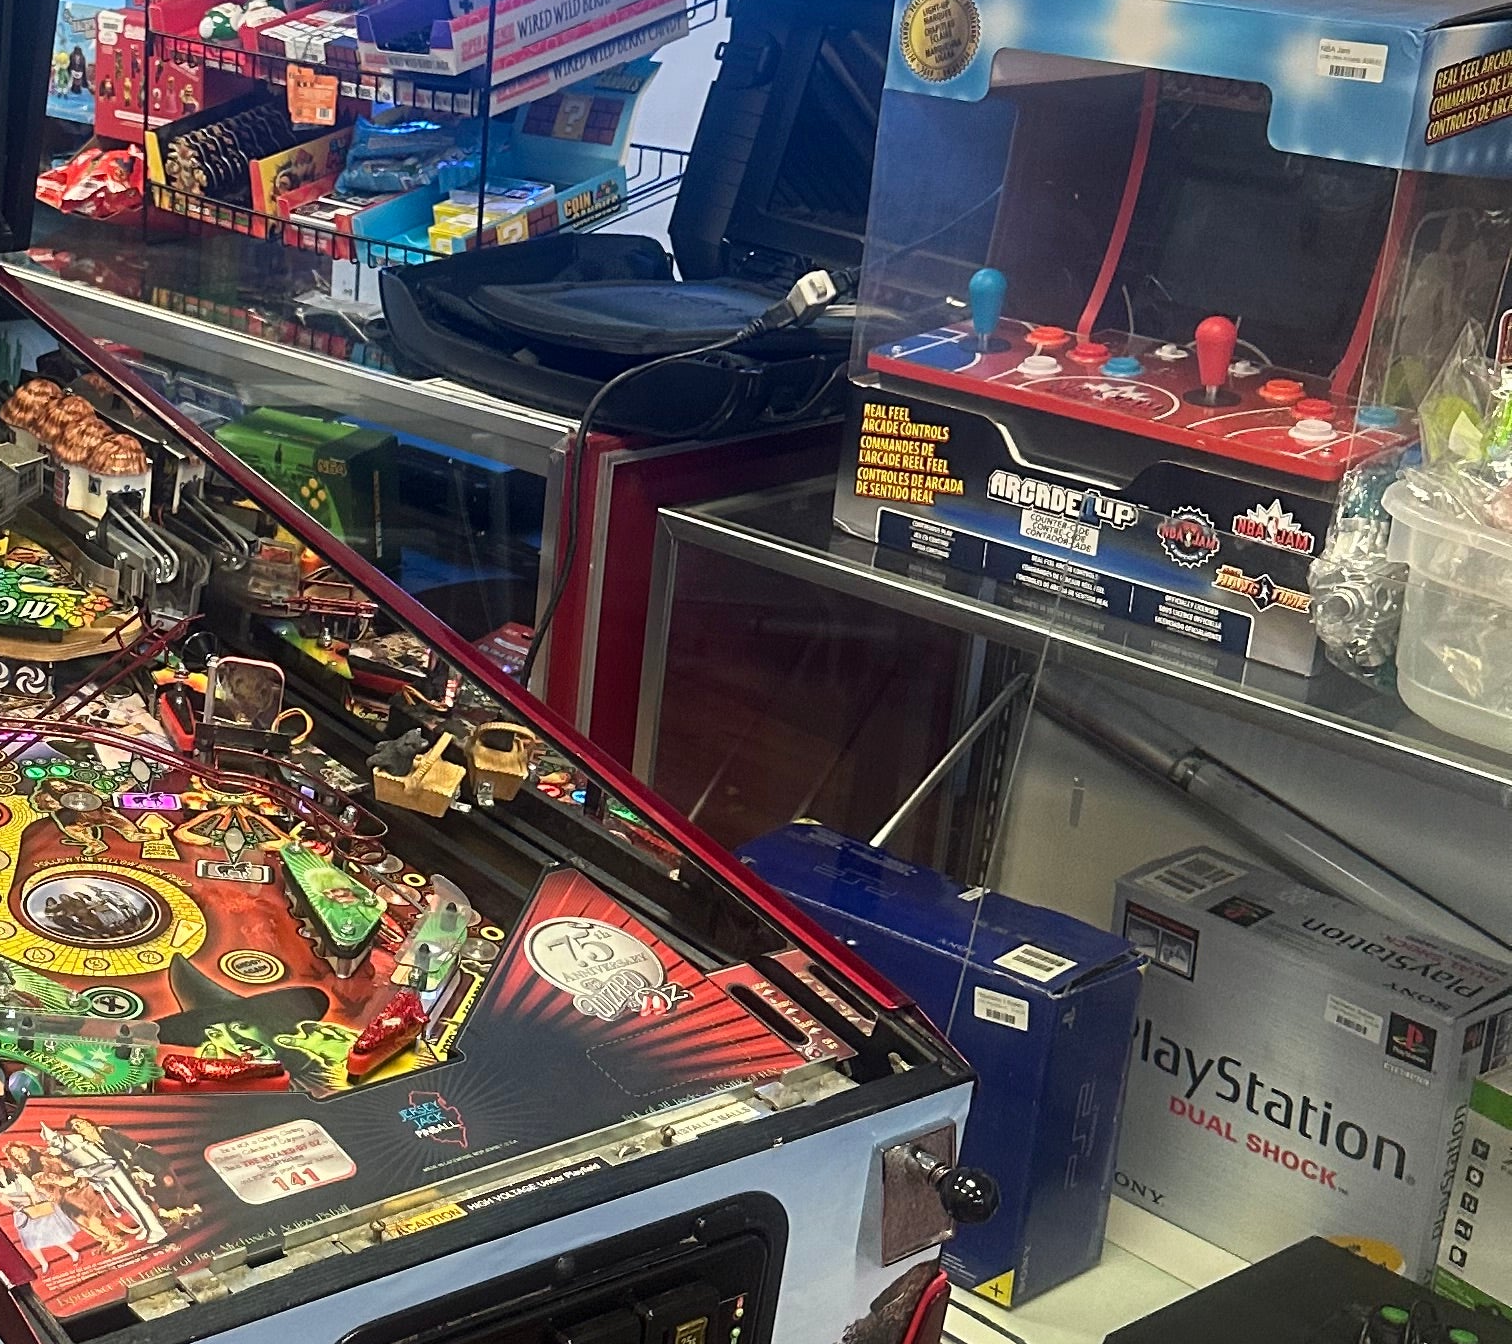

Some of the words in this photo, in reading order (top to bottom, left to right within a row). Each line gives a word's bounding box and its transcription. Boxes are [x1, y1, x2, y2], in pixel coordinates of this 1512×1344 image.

[516, 9, 554, 39] WIRED
[553, 1, 583, 28] WILD
[1436, 67, 1458, 90] REAL
[1459, 59, 1481, 82] FEEL
[1431, 78, 1490, 116] COMMANDES
[1488, 75, 1503, 95] DE
[1427, 106, 1479, 140] CONTROLES
[1477, 101, 1491, 122] DE
[563, 190, 594, 219] COIN
[863, 403, 888, 419] REAL
[888, 406, 911, 422] FEEL
[861, 418, 900, 435] ARCADE
[899, 421, 950, 440] CONTROLS
[860, 435, 921, 455] COMMANDES
[921, 442, 936, 457] DE
[858, 449, 901, 469] L'ARCADE
[926, 457, 950, 475] FEEL
[855, 480, 869, 495] DE
[869, 483, 910, 500] SENTIDO
[910, 487, 935, 504] REAL
[856, 466, 910, 486] CONTROLES
[910, 474, 924, 488] DE
[924, 475, 965, 495] ARCADA
[1161, 525, 1184, 543] NBA
[1192, 532, 1219, 551] JAM
[1236, 518, 1266, 540] NBA
[1275, 529, 1311, 551] JAM
[547, 929, 615, 968] 75th
[1300, 912, 1486, 1000] PlayStation
[561, 953, 650, 984] ANNIVERSARY
[397, 1099, 441, 1123] JERSEY
[1132, 1015, 1406, 1182] layStation
[413, 1111, 446, 1130] JACK
[719, 1106, 752, 1122] BALLS
[414, 1119, 461, 1139] PINBALL
[1169, 1095, 1238, 1144] DUAL
[1245, 1131, 1338, 1192] SHOCK
[271, 1167, 321, 1191] 141
[1112, 1169, 1165, 1208] ONY
[405, 1207, 463, 1234] CAUTION
[466, 1196, 493, 1212] HIGH
[492, 1183, 540, 1203] VOLTAGE
[538, 1173, 566, 1189] Under
[562, 1162, 602, 1184] Playfield
